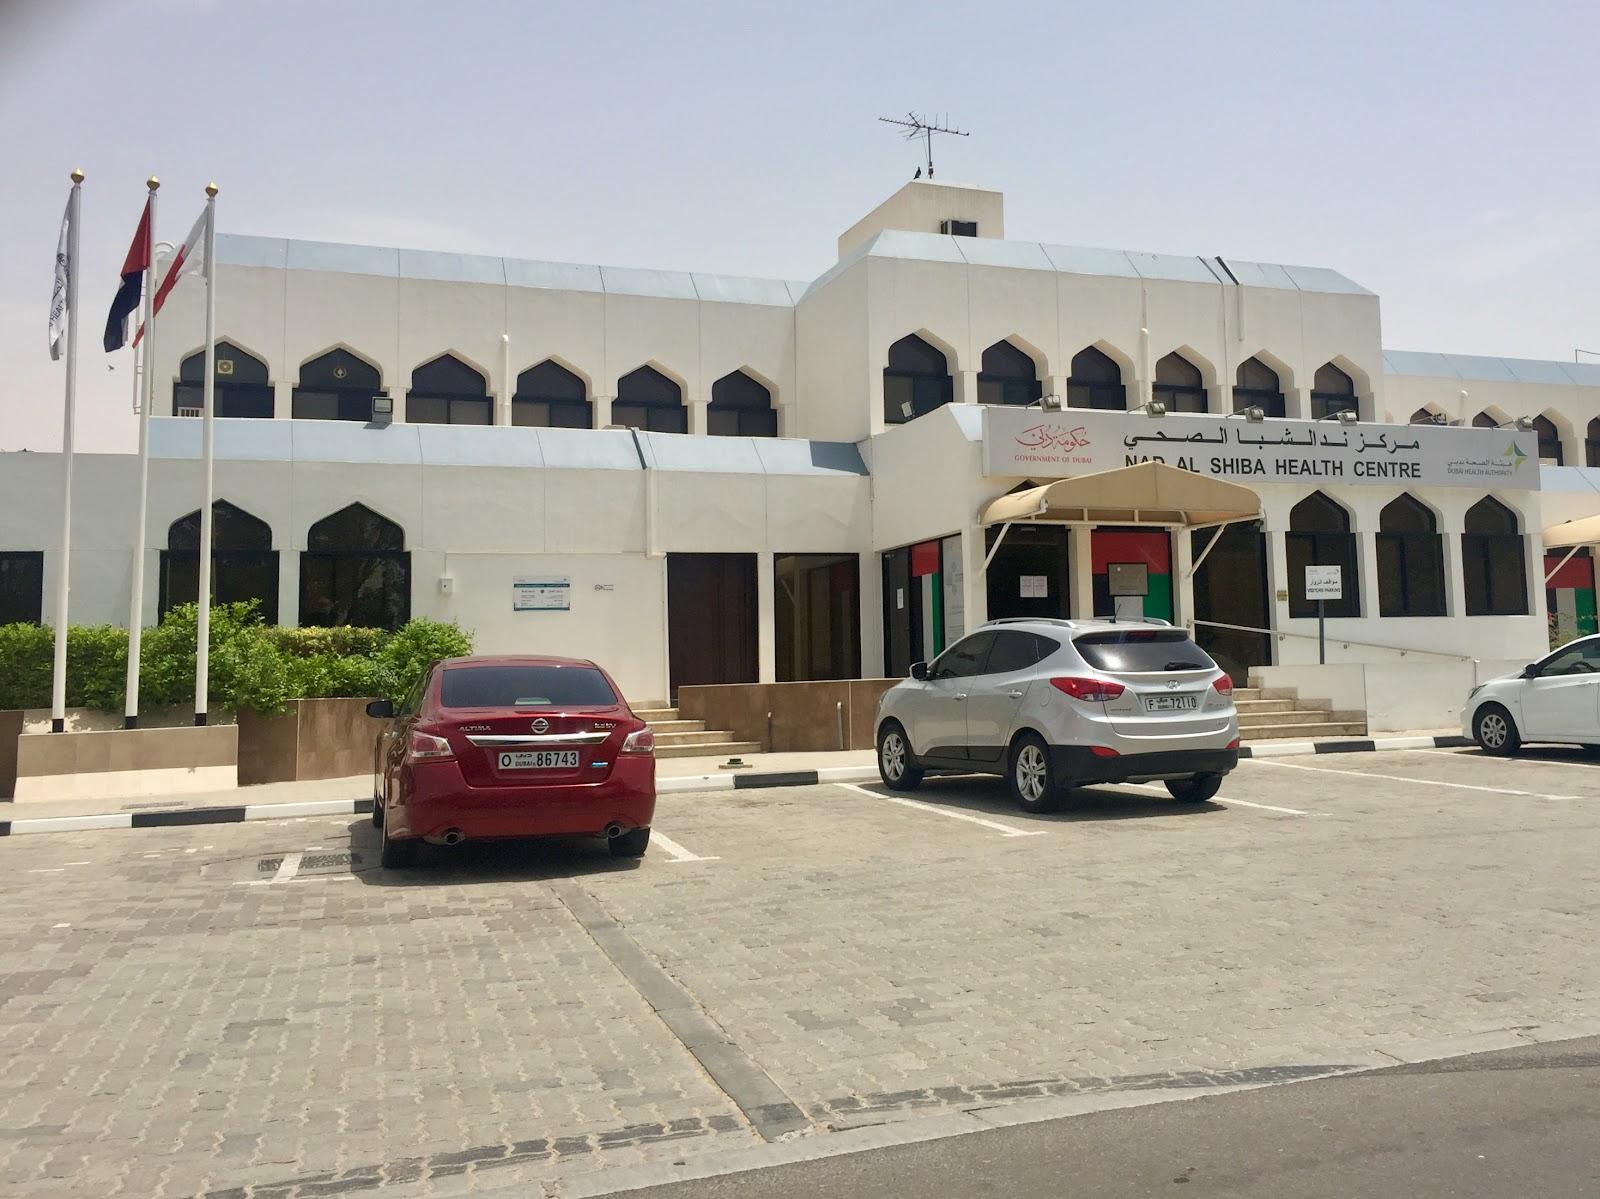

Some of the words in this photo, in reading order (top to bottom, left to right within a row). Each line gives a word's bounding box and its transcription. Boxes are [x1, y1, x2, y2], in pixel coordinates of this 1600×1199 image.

[1123, 426, 1228, 451] الصحي
[1236, 427, 1316, 450] الشبا
[1320, 431, 1348, 447] ند
[1355, 432, 1420, 454] مركز
[1014, 455, 1059, 463] GOVERNMENT
[1177, 456, 1200, 473] AL
[1210, 457, 1266, 475] SHIBA
[1275, 458, 1343, 476] HEALTH
[1353, 460, 1421, 478] CENTRE
[1447, 467, 1464, 475] DUBAI
[1464, 468, 1485, 476] HEALTH
[1485, 469, 1513, 477] AUTHORITY
[1148, 699, 1154, 710] F
[1170, 696, 1197, 709] 72110
[458, 725, 492, 733] ALTIMA
[536, 752, 577, 767] 86743
